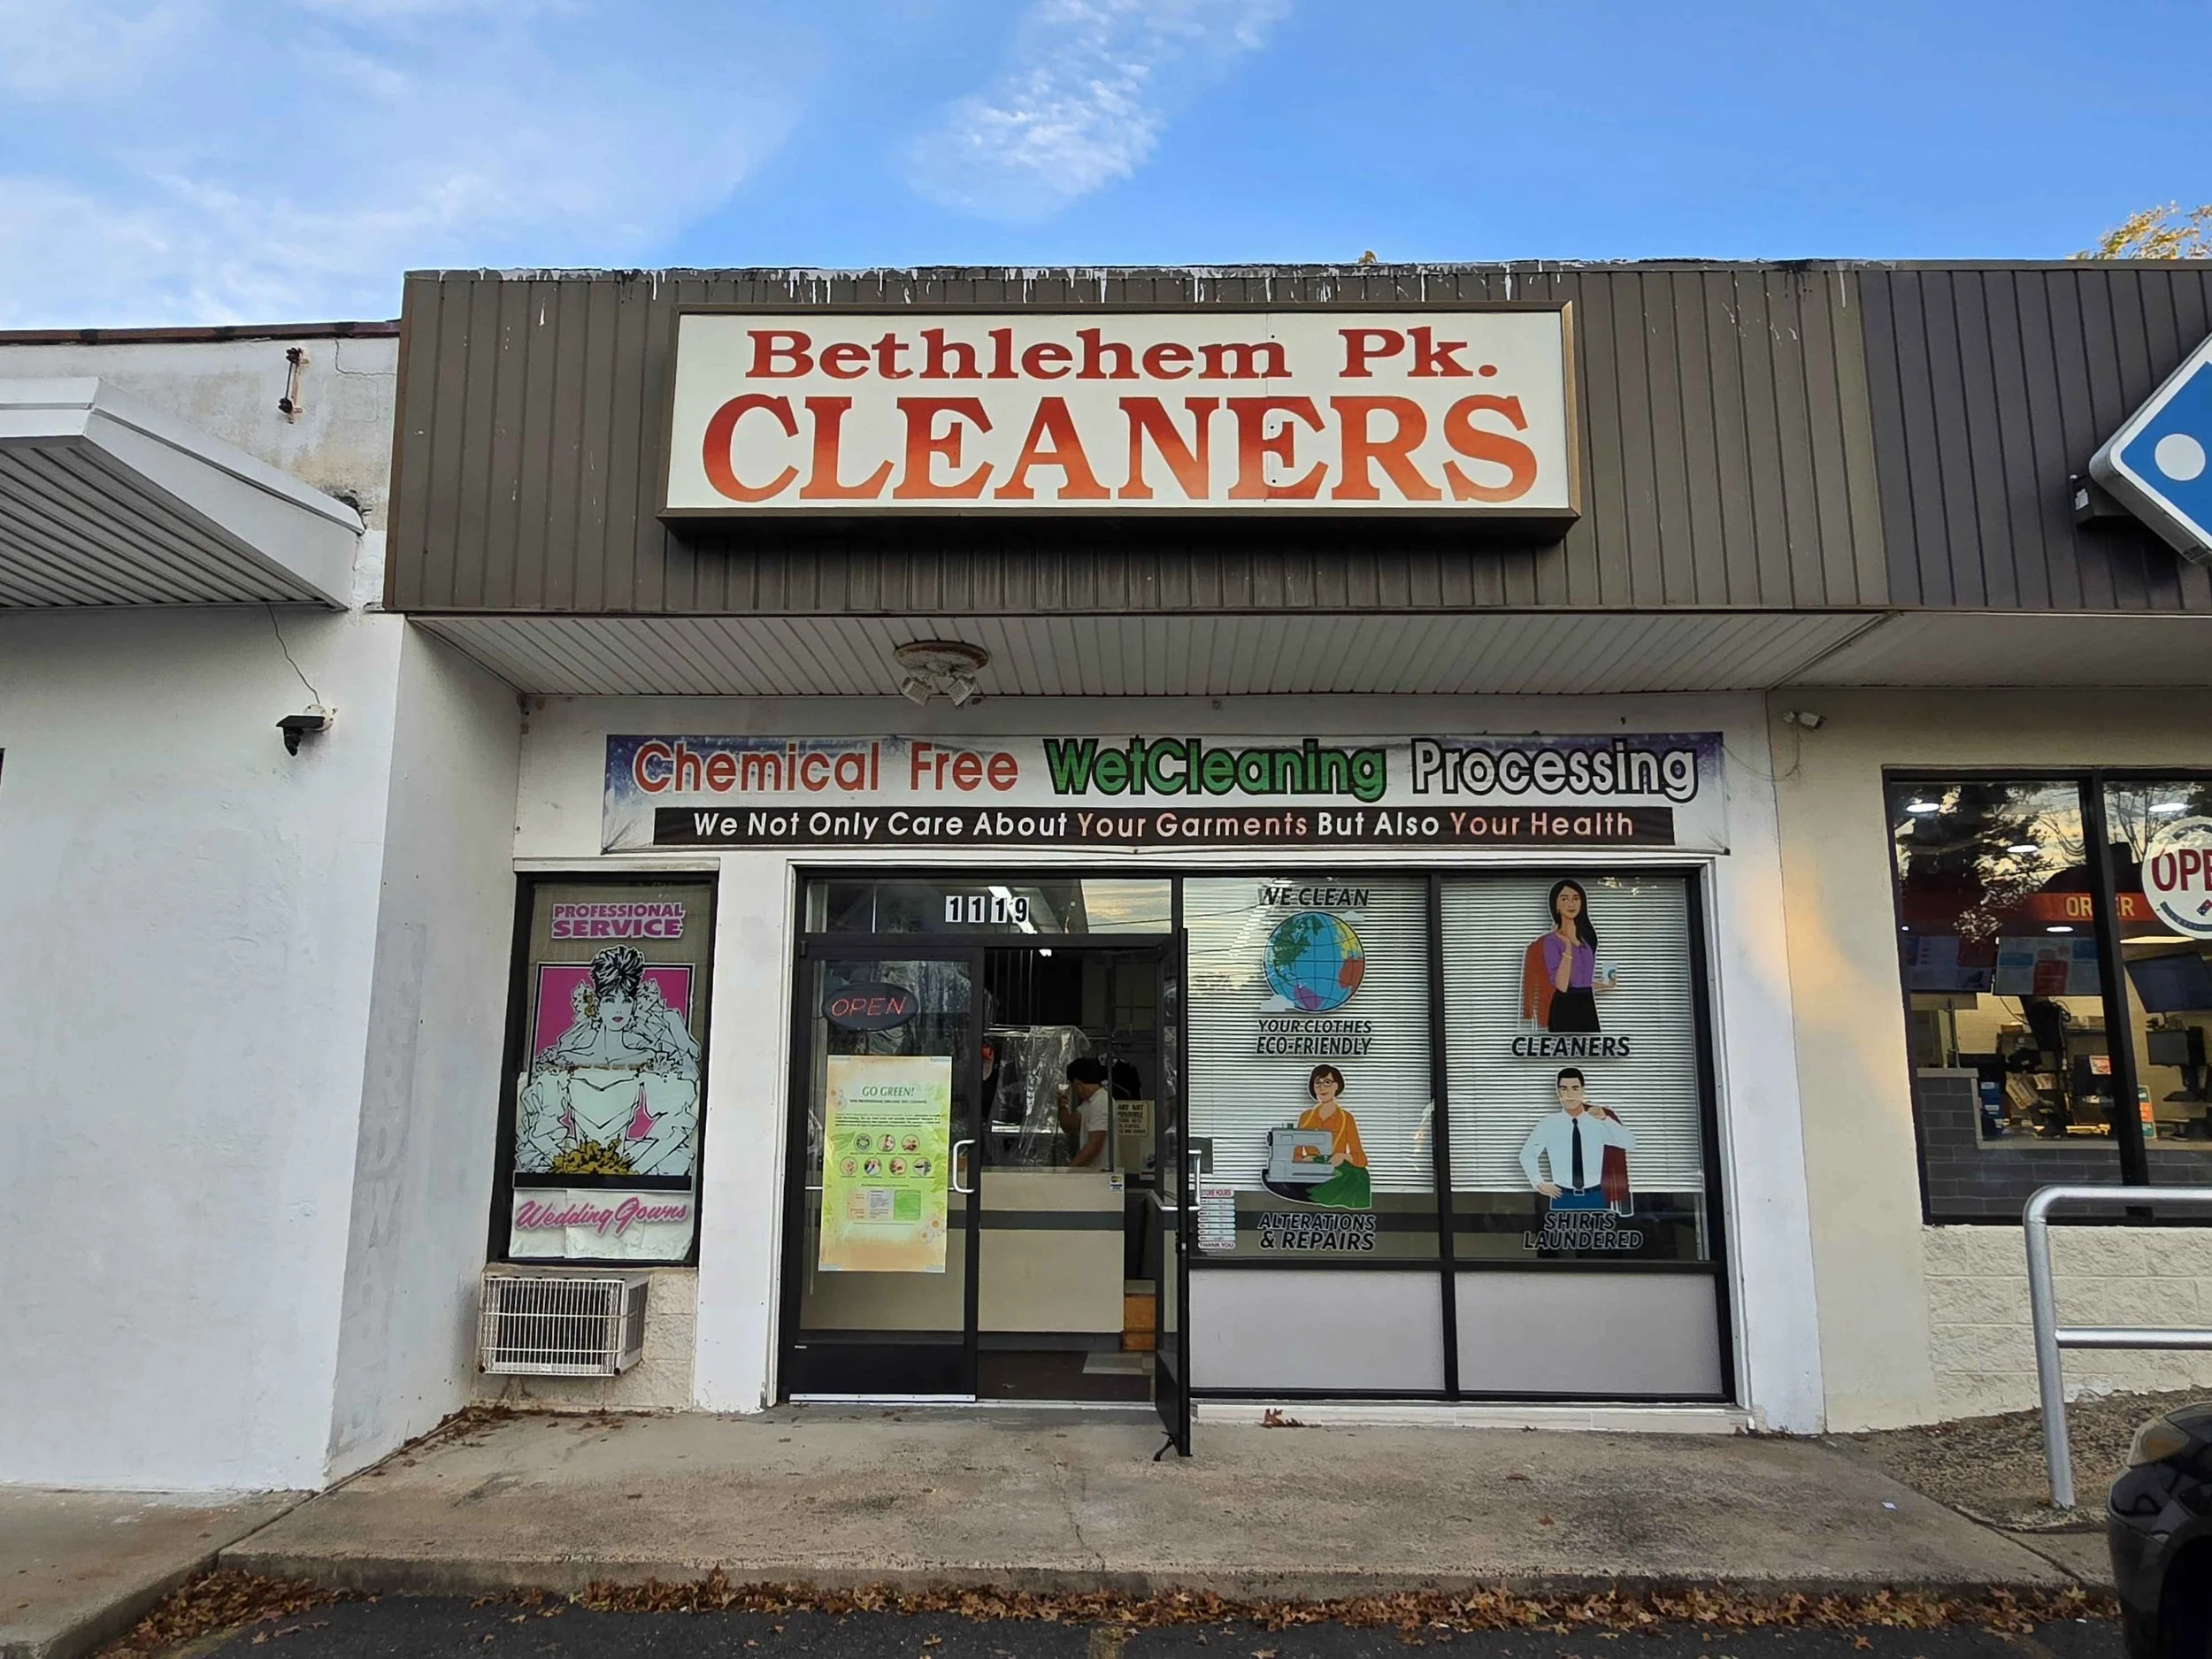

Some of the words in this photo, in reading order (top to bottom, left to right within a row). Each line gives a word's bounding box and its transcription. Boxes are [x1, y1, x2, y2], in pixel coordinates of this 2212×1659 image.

[745, 327, 1292, 380] Bethlehem
[1338, 326, 1498, 379] Pk.
[702, 392, 1538, 503] CLEANERS
[633, 741, 879, 794] Chemical
[910, 741, 1018, 792] Free
[1043, 735, 1386, 803] WetCleaning
[1410, 736, 1699, 803] Processing
[694, 812, 737, 836] We
[748, 812, 800, 836] Not
[809, 810, 879, 840] Only
[887, 812, 963, 836] Care
[973, 811, 1067, 836] About
[1077, 812, 1146, 837] Your
[1156, 812, 1308, 836] Garments
[1317, 812, 1363, 836] But
[1374, 812, 1440, 836] Also
[1450, 812, 1520, 836] Your
[1531, 811, 1634, 836] Health
[1258, 887, 1295, 908] WE
[1298, 887, 1370, 908] CLEAN
[2065, 896, 2135, 917] ORR
[553, 903, 685, 918] PROFESSIONAL
[947, 896, 1028, 922] 1119
[552, 919, 683, 939] SERVICE
[832, 996, 907, 1017] OPEN
[1258, 1019, 1300, 1034] YOUR
[1303, 1019, 1372, 1034] CLOTHES
[1256, 1036, 1372, 1056] ECO-FRIENDLY
[1511, 1036, 1631, 1057] CLEANERS
[862, 1087, 878, 1096] GO
[880, 1087, 915, 1097] GREEN!
[516, 1199, 612, 1233] Wedding
[614, 1196, 688, 1233] Gowns
[1259, 1213, 1376, 1231] ALTERATIONS
[1544, 1212, 1616, 1231] SHIRTS
[1260, 1233, 1275, 1249] &
[1281, 1232, 1375, 1250] REPAIRS
[1523, 1232, 1643, 1250] LAUNDERED
